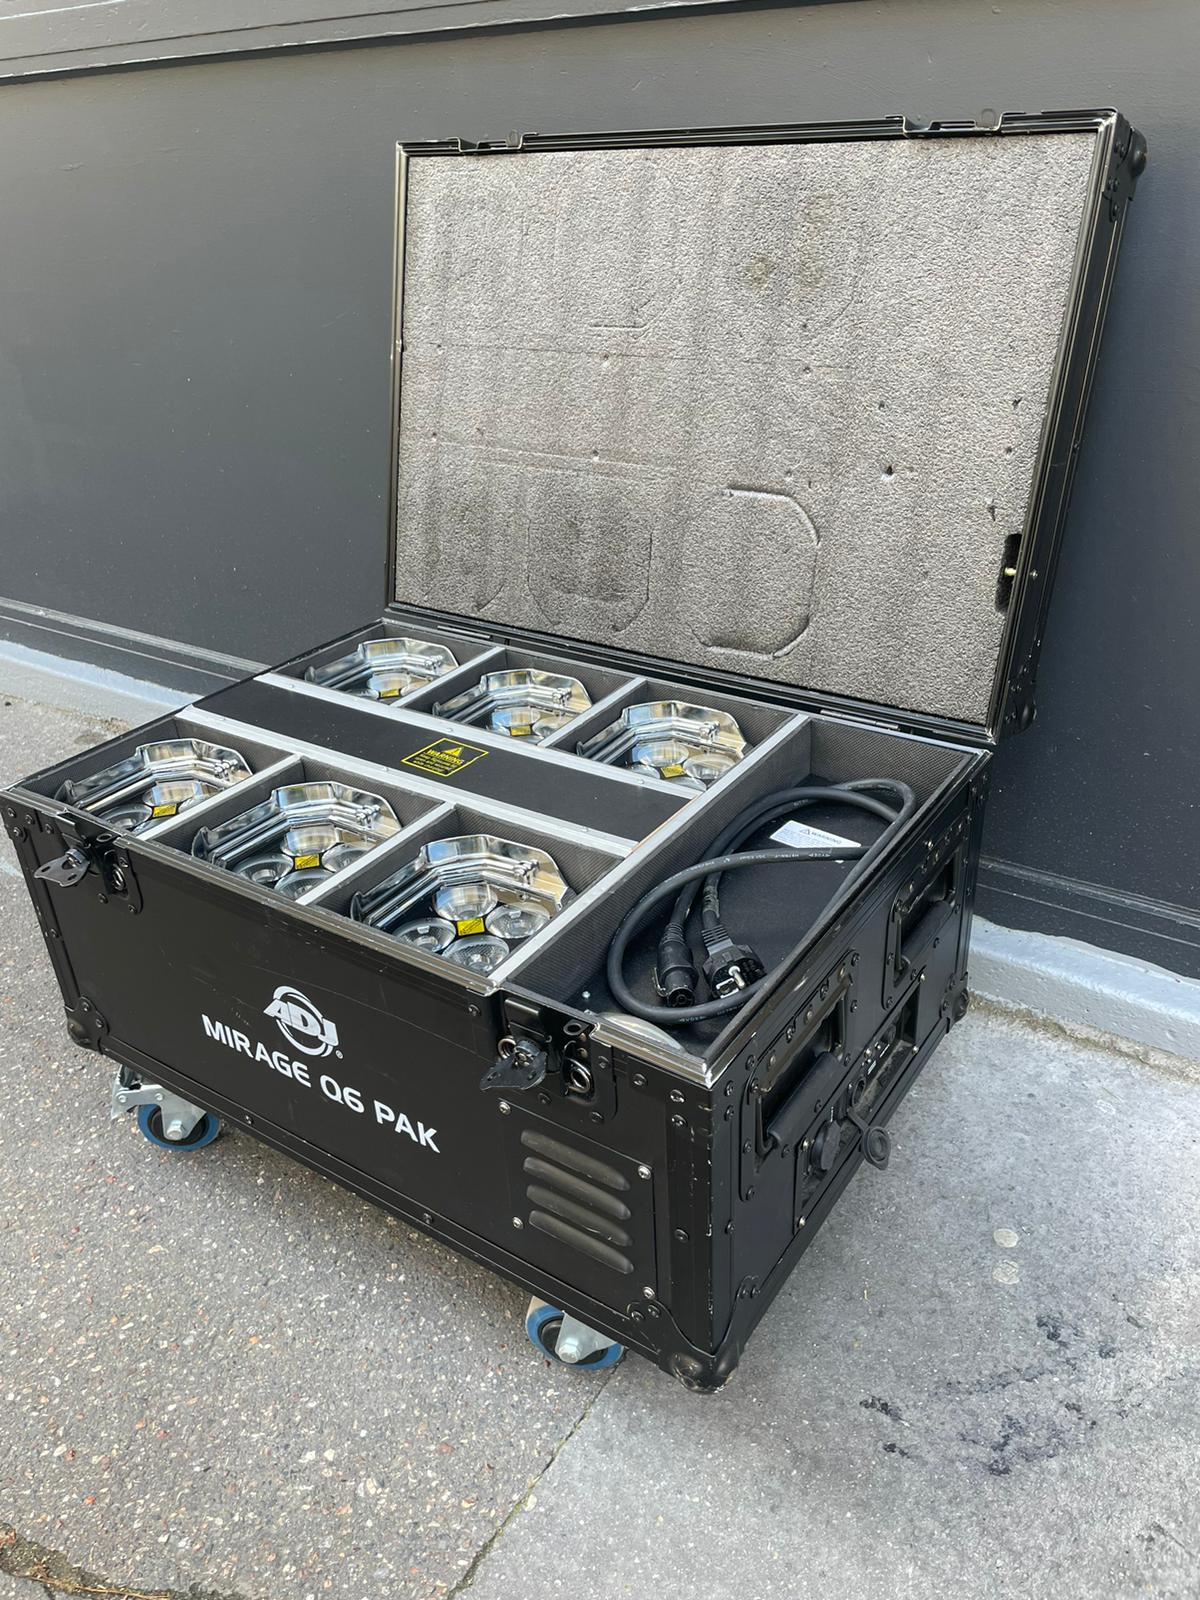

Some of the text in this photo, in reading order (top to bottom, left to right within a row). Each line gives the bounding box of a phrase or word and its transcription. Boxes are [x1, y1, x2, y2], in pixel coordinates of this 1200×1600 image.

[426, 749, 465, 764] WARNING
[811, 831, 842, 845] WARNING
[263, 998, 339, 1047] ADJ
[201, 1013, 440, 1153] MIRAGE Q6 PAK
